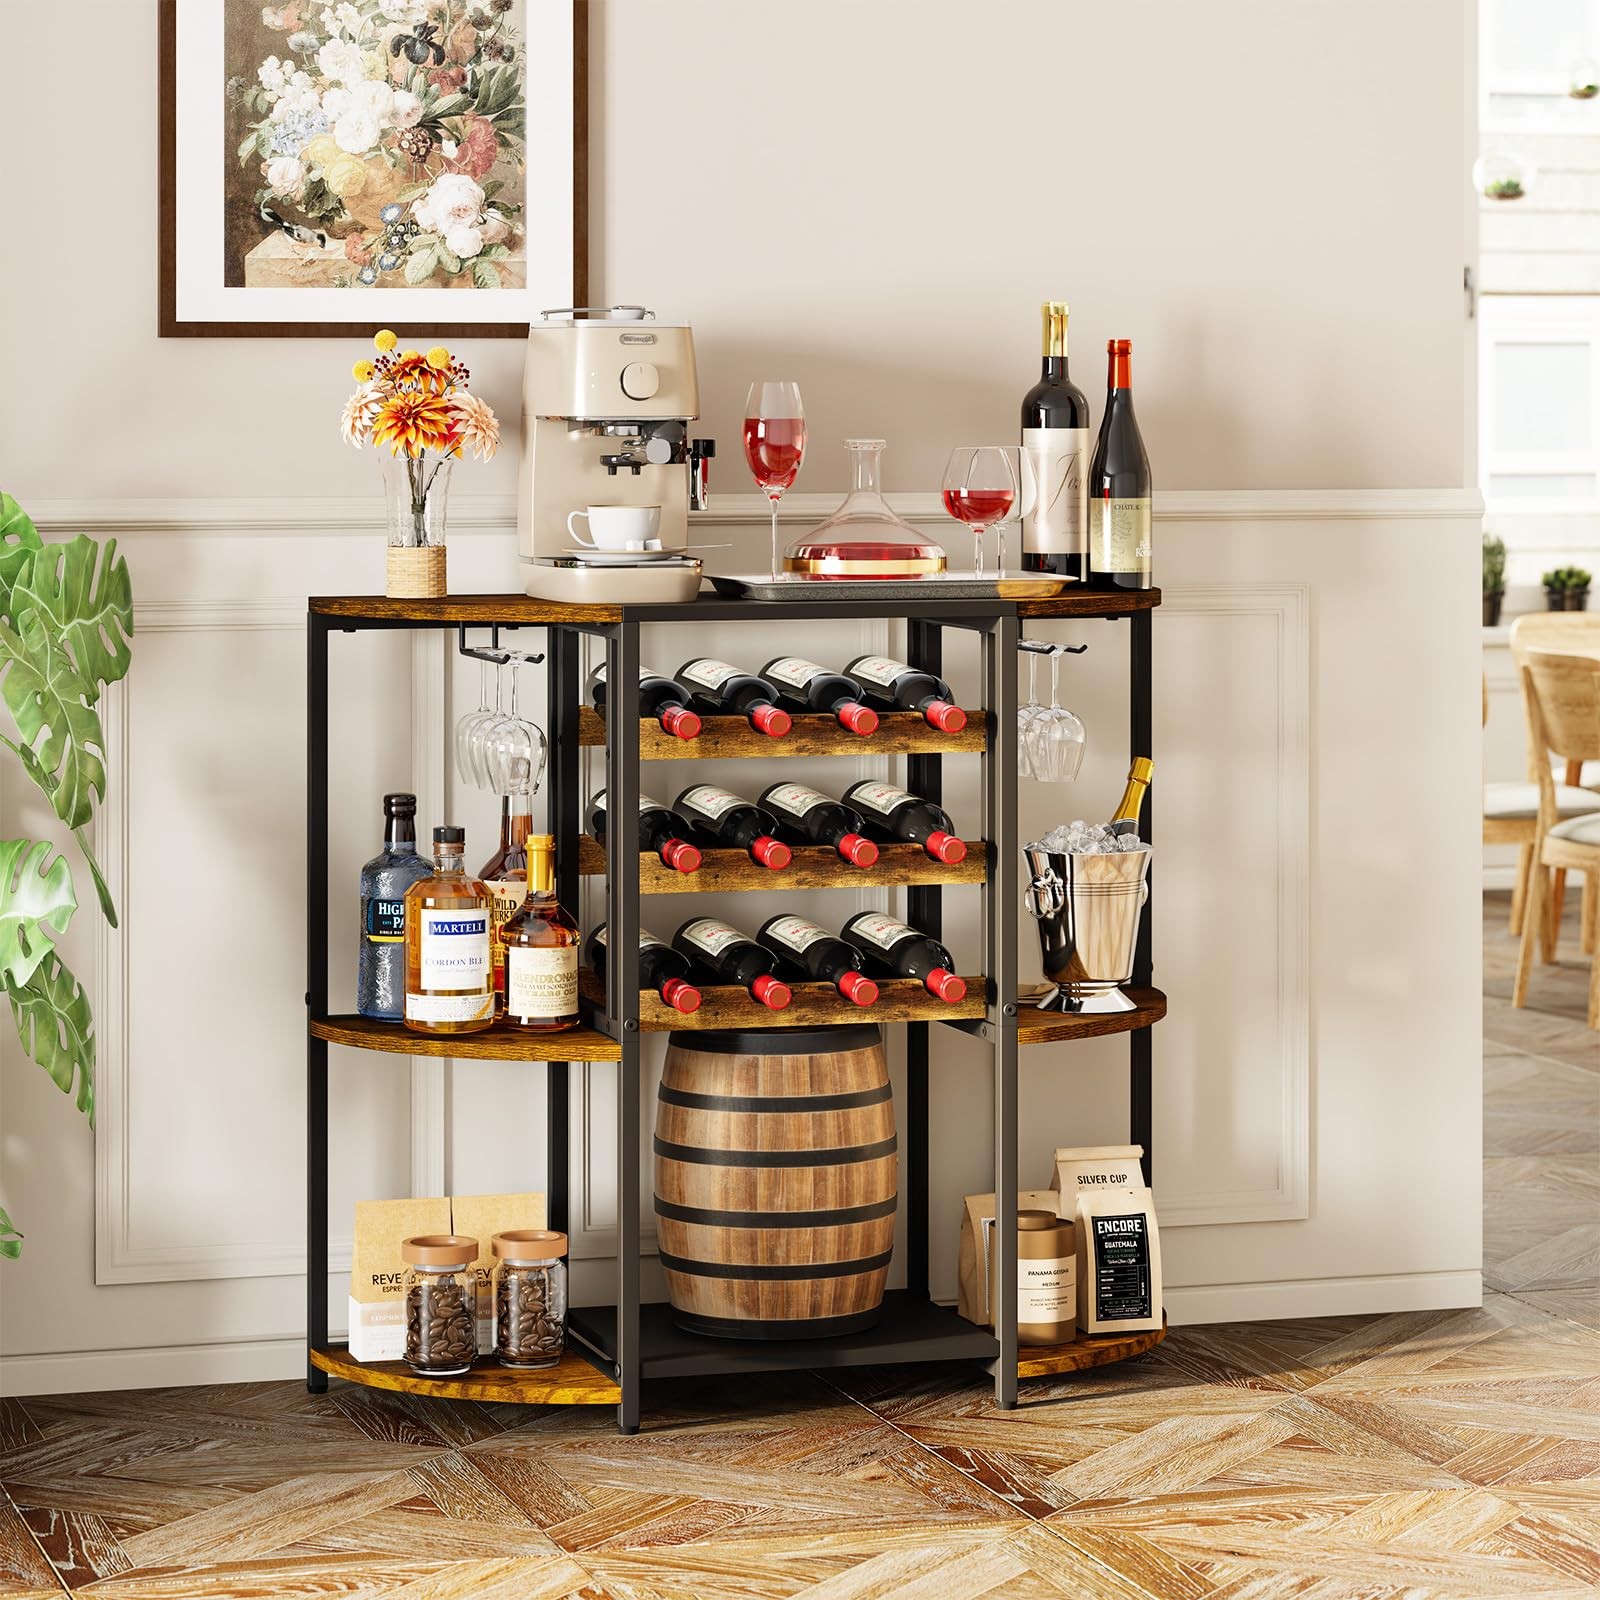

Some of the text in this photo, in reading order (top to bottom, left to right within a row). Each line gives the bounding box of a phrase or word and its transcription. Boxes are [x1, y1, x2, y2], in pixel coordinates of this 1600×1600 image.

[494, 897, 517, 910] WILD
[432, 923, 484, 933] MARTELL
[425, 958, 466, 966] CORDON
[1077, 1174, 1128, 1185] SILVER CUP
[1097, 1219, 1142, 1234] ENCORE
[1104, 1240, 1138, 1249] GUATEMALA
